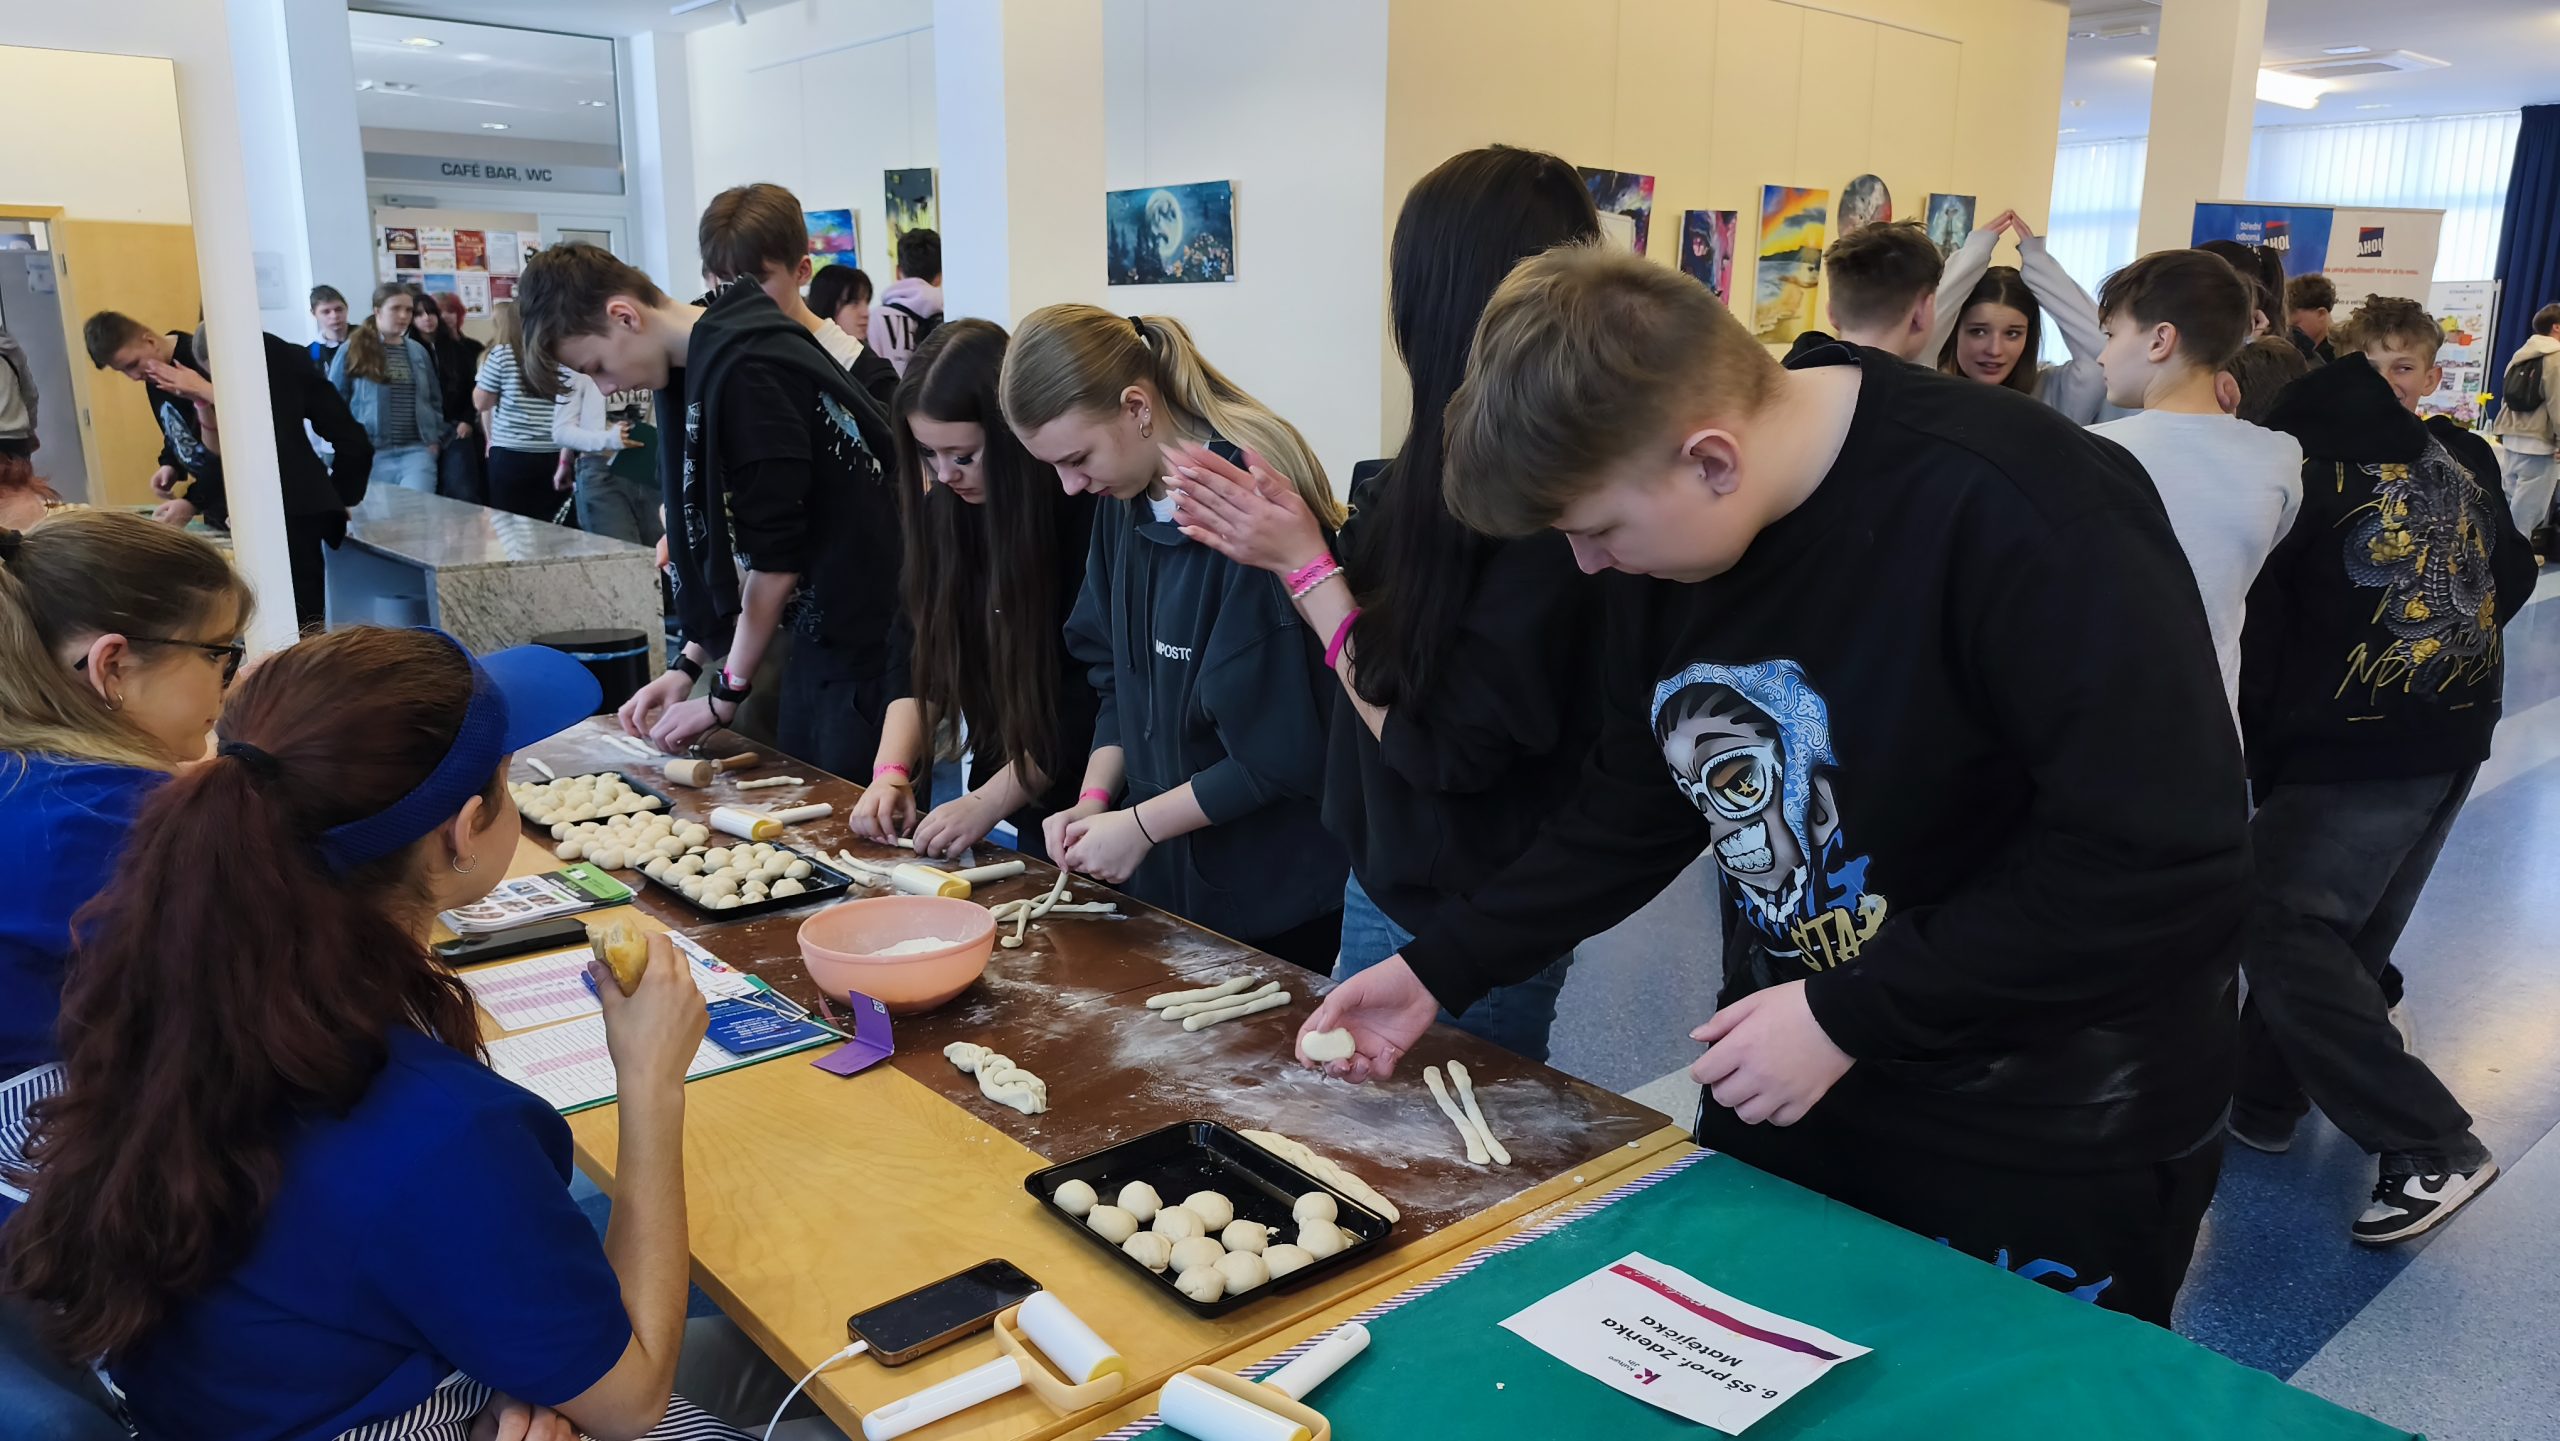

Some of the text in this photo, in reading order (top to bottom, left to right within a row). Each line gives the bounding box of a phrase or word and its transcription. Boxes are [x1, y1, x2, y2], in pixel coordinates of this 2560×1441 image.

[441, 162, 553, 182] CAFÉ BAR, WC
[1601, 1317, 1778, 1399] 6. SŠ prof. Zdeňka
[1640, 1316, 1743, 1367] Matějíčka
